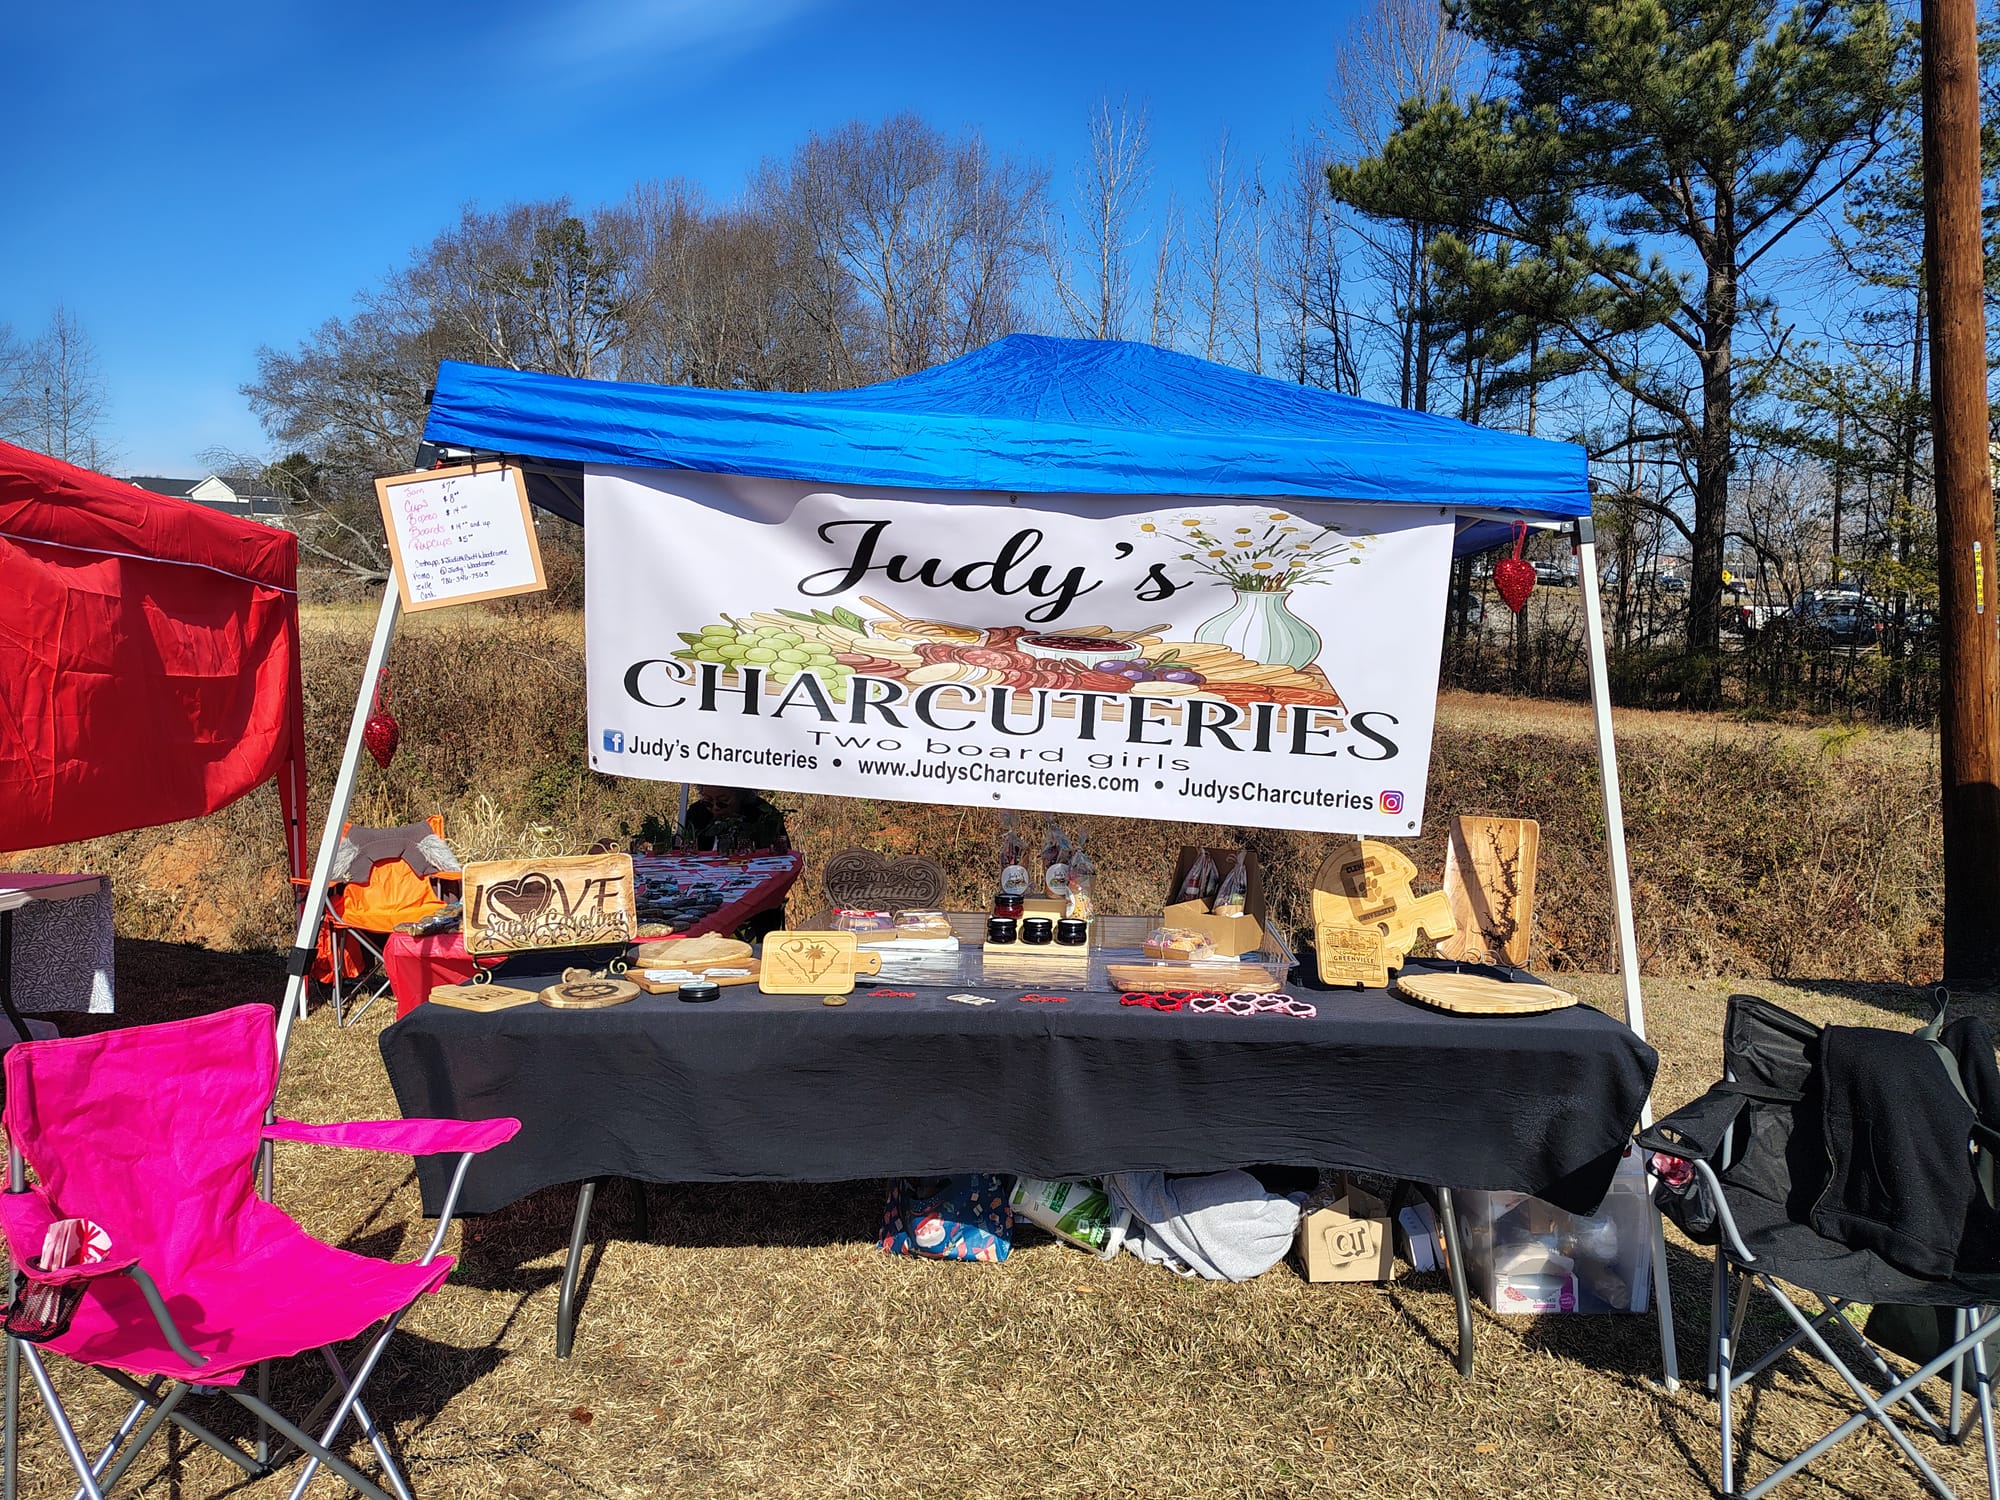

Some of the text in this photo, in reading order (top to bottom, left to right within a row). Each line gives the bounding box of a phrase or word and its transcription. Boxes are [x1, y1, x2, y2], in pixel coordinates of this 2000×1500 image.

[797, 519, 1195, 624] Judy's
[623, 659, 1400, 762] CHARCUTERIES
[629, 735, 690, 762] Judy's
[696, 741, 818, 770] Charcuteries
[807, 729, 1191, 771] Two board girls
[858, 758, 1139, 793] www.JudysCharcuteries.com
[1178, 776, 1374, 810] JudysCharcuteries
[834, 881, 930, 900] Valentine
[841, 871, 891, 883] BE MY
[1333, 955, 1375, 964] GREENVILLE
[1330, 1226, 1366, 1258] QT
